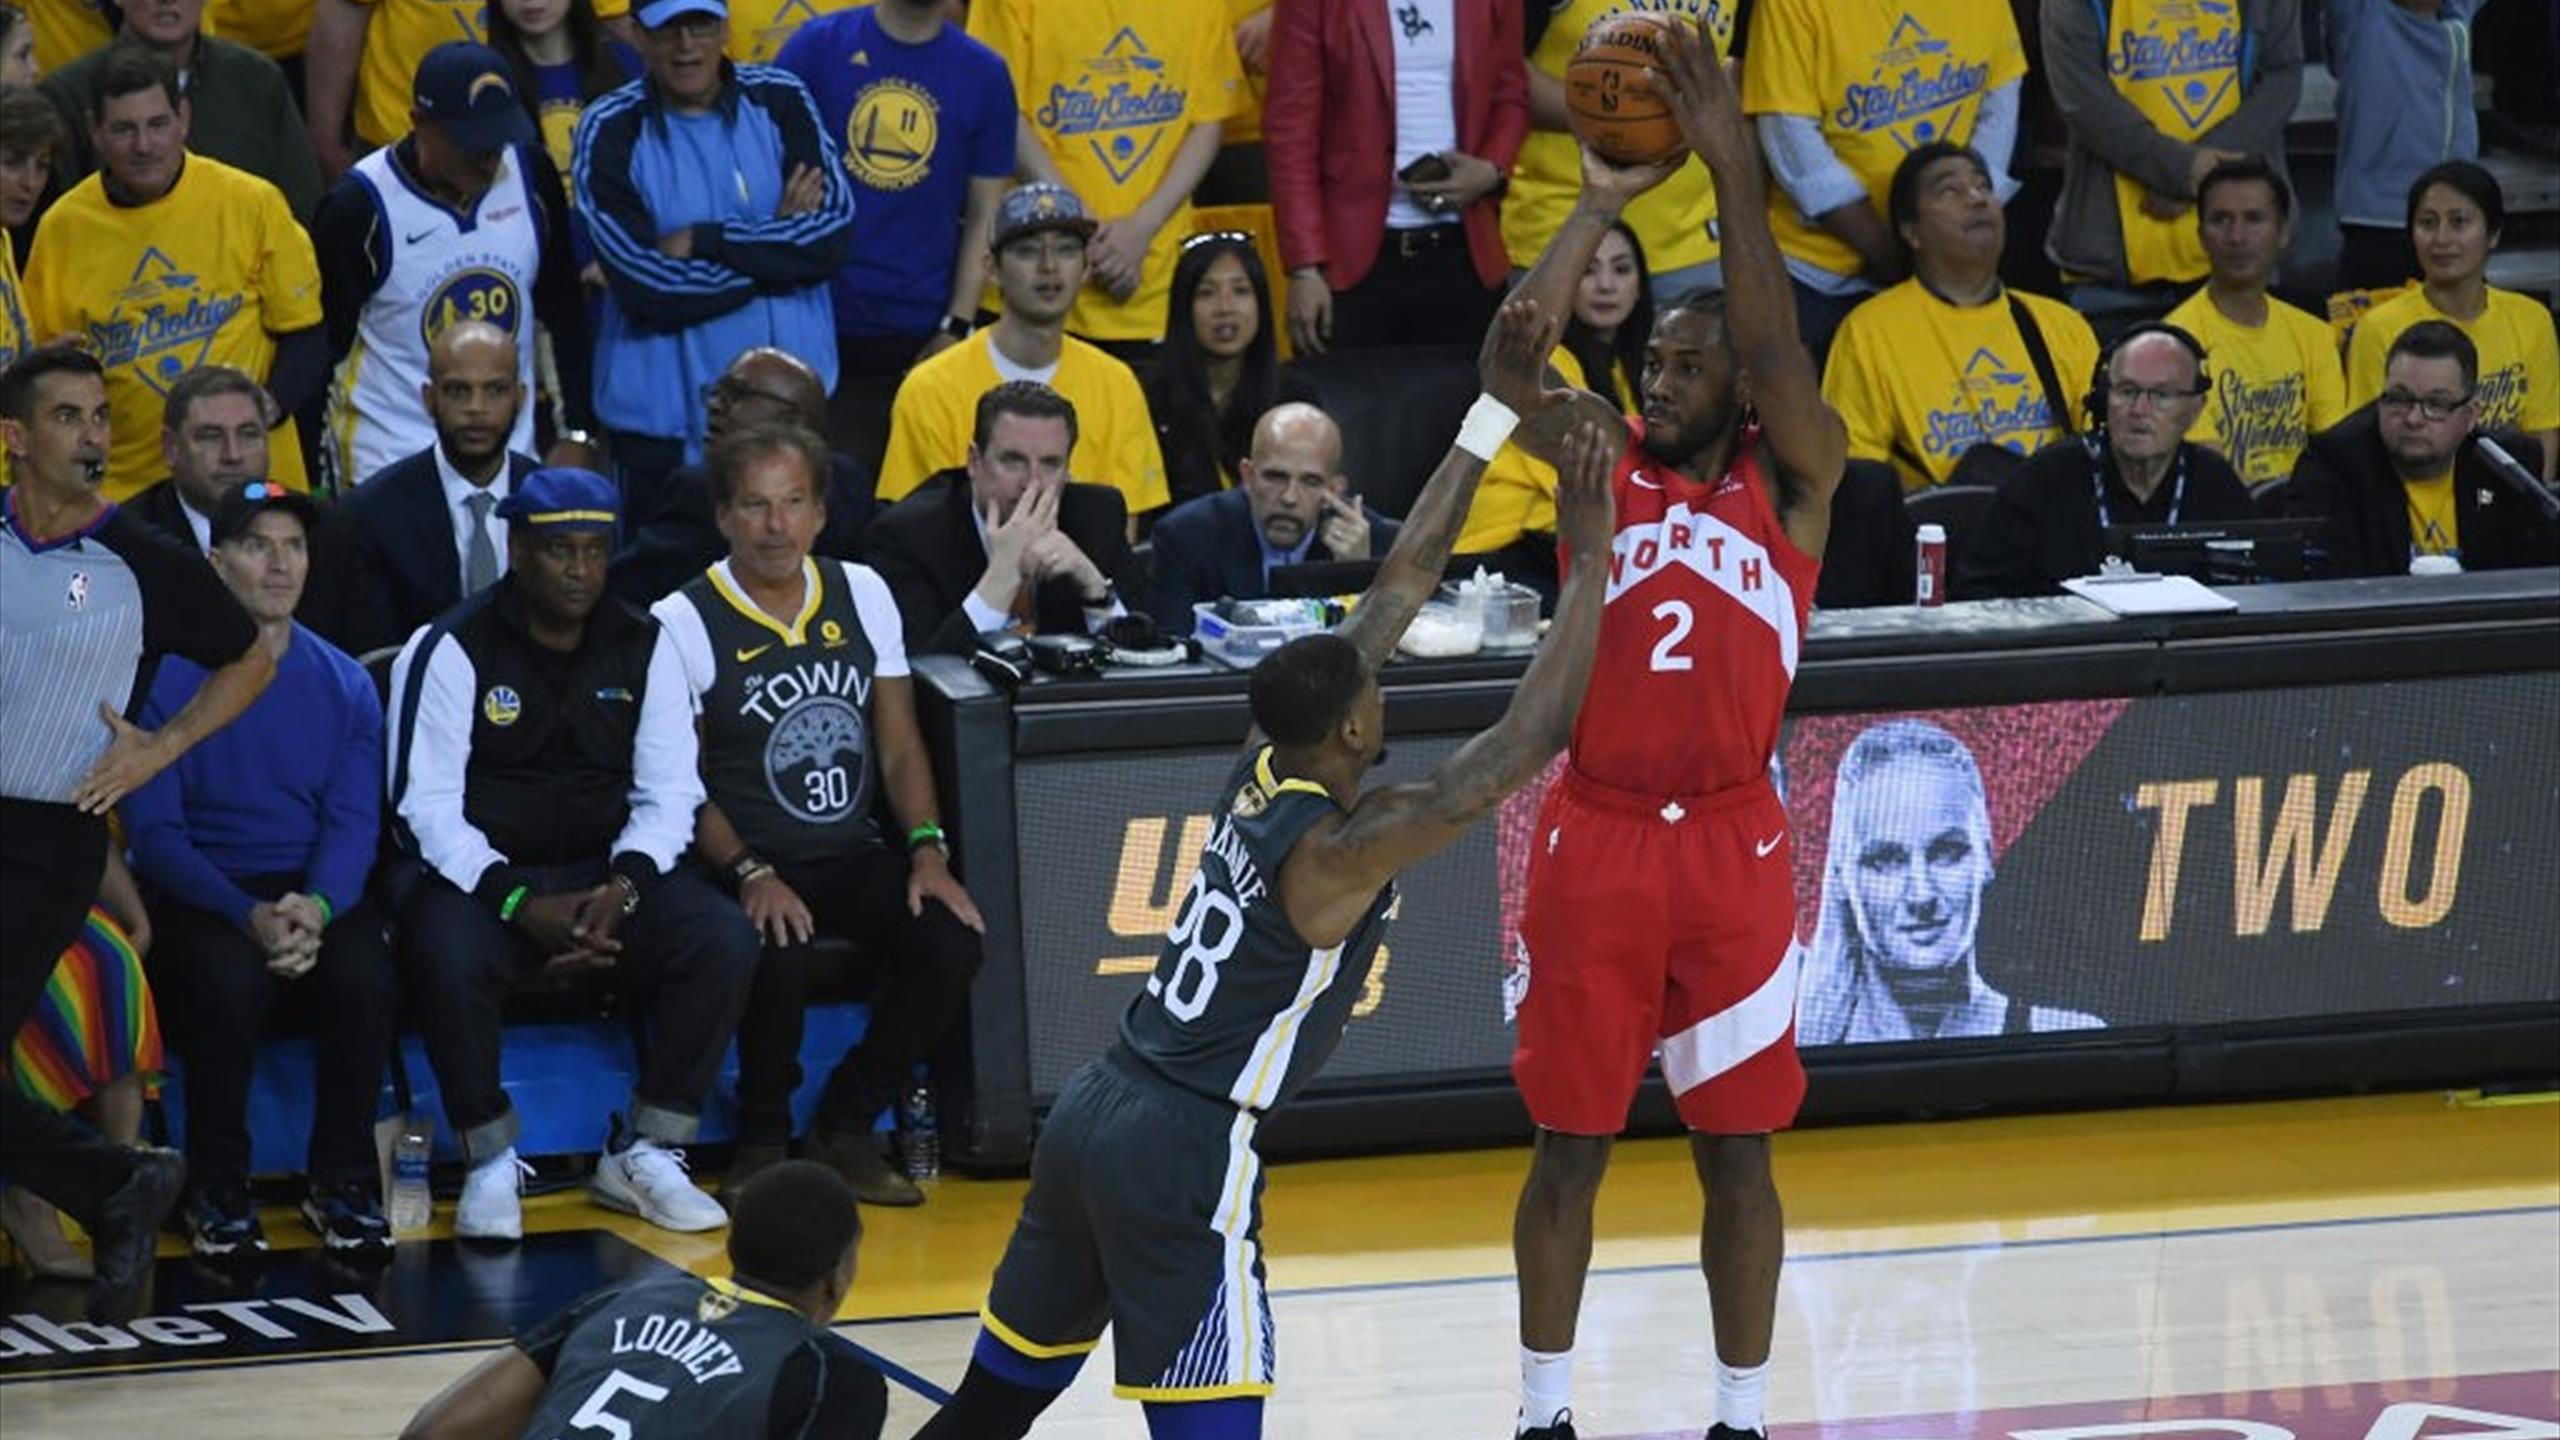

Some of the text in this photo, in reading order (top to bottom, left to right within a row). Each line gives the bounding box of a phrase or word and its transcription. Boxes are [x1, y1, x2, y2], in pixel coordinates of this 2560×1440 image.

[2108, 19, 2172, 80] Stay
[1038, 74, 1104, 133] Stay
[1836, 67, 1897, 133] Stay
[468, 286, 508, 320] 30
[1608, 524, 1763, 592] NORTH
[1651, 599, 1694, 672] 2
[740, 660, 871, 724] TOWN
[805, 766, 849, 812] 30
[2136, 761, 2472, 941] TWO
[612, 1314, 743, 1384] LOONEY
[569, 1368, 671, 1440] 5
